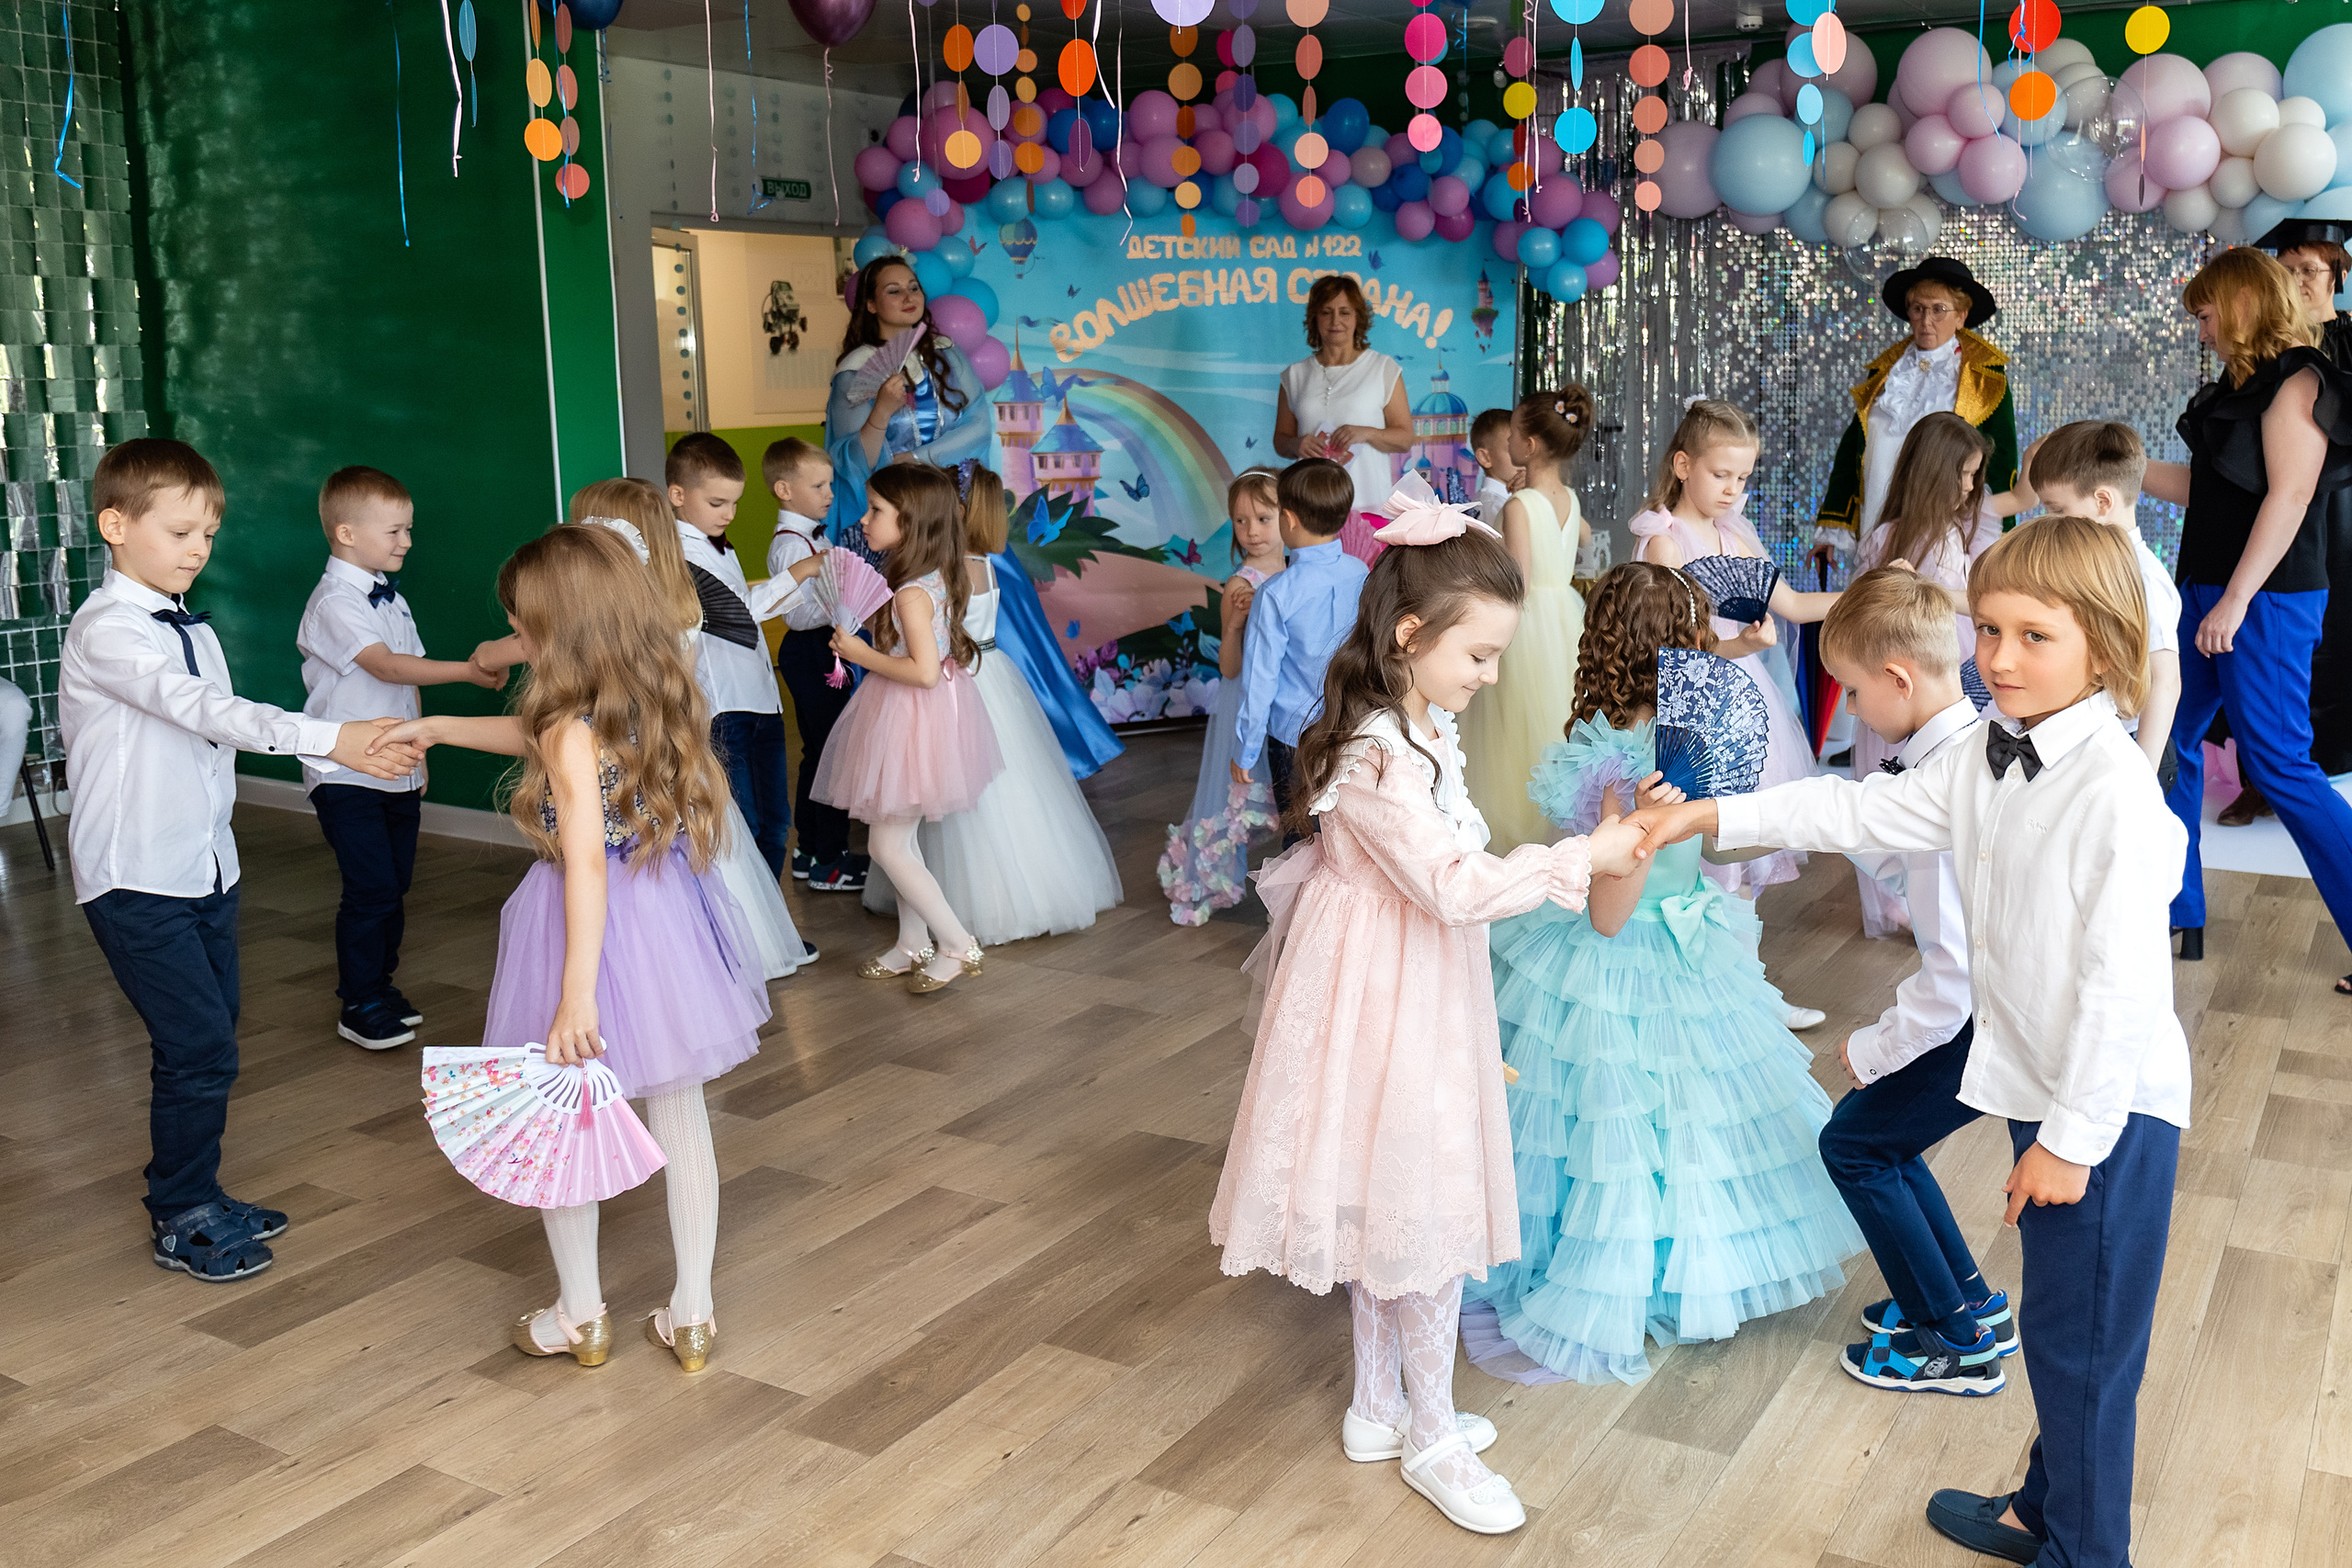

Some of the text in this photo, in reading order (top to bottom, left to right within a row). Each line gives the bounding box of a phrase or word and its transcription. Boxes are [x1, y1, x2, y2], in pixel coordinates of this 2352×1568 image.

[766, 181, 807, 197] ВЫХОД
[1250, 235, 1297, 259] САД
[1049, 266, 1278, 363] ВОЛШЕБНАЯ
